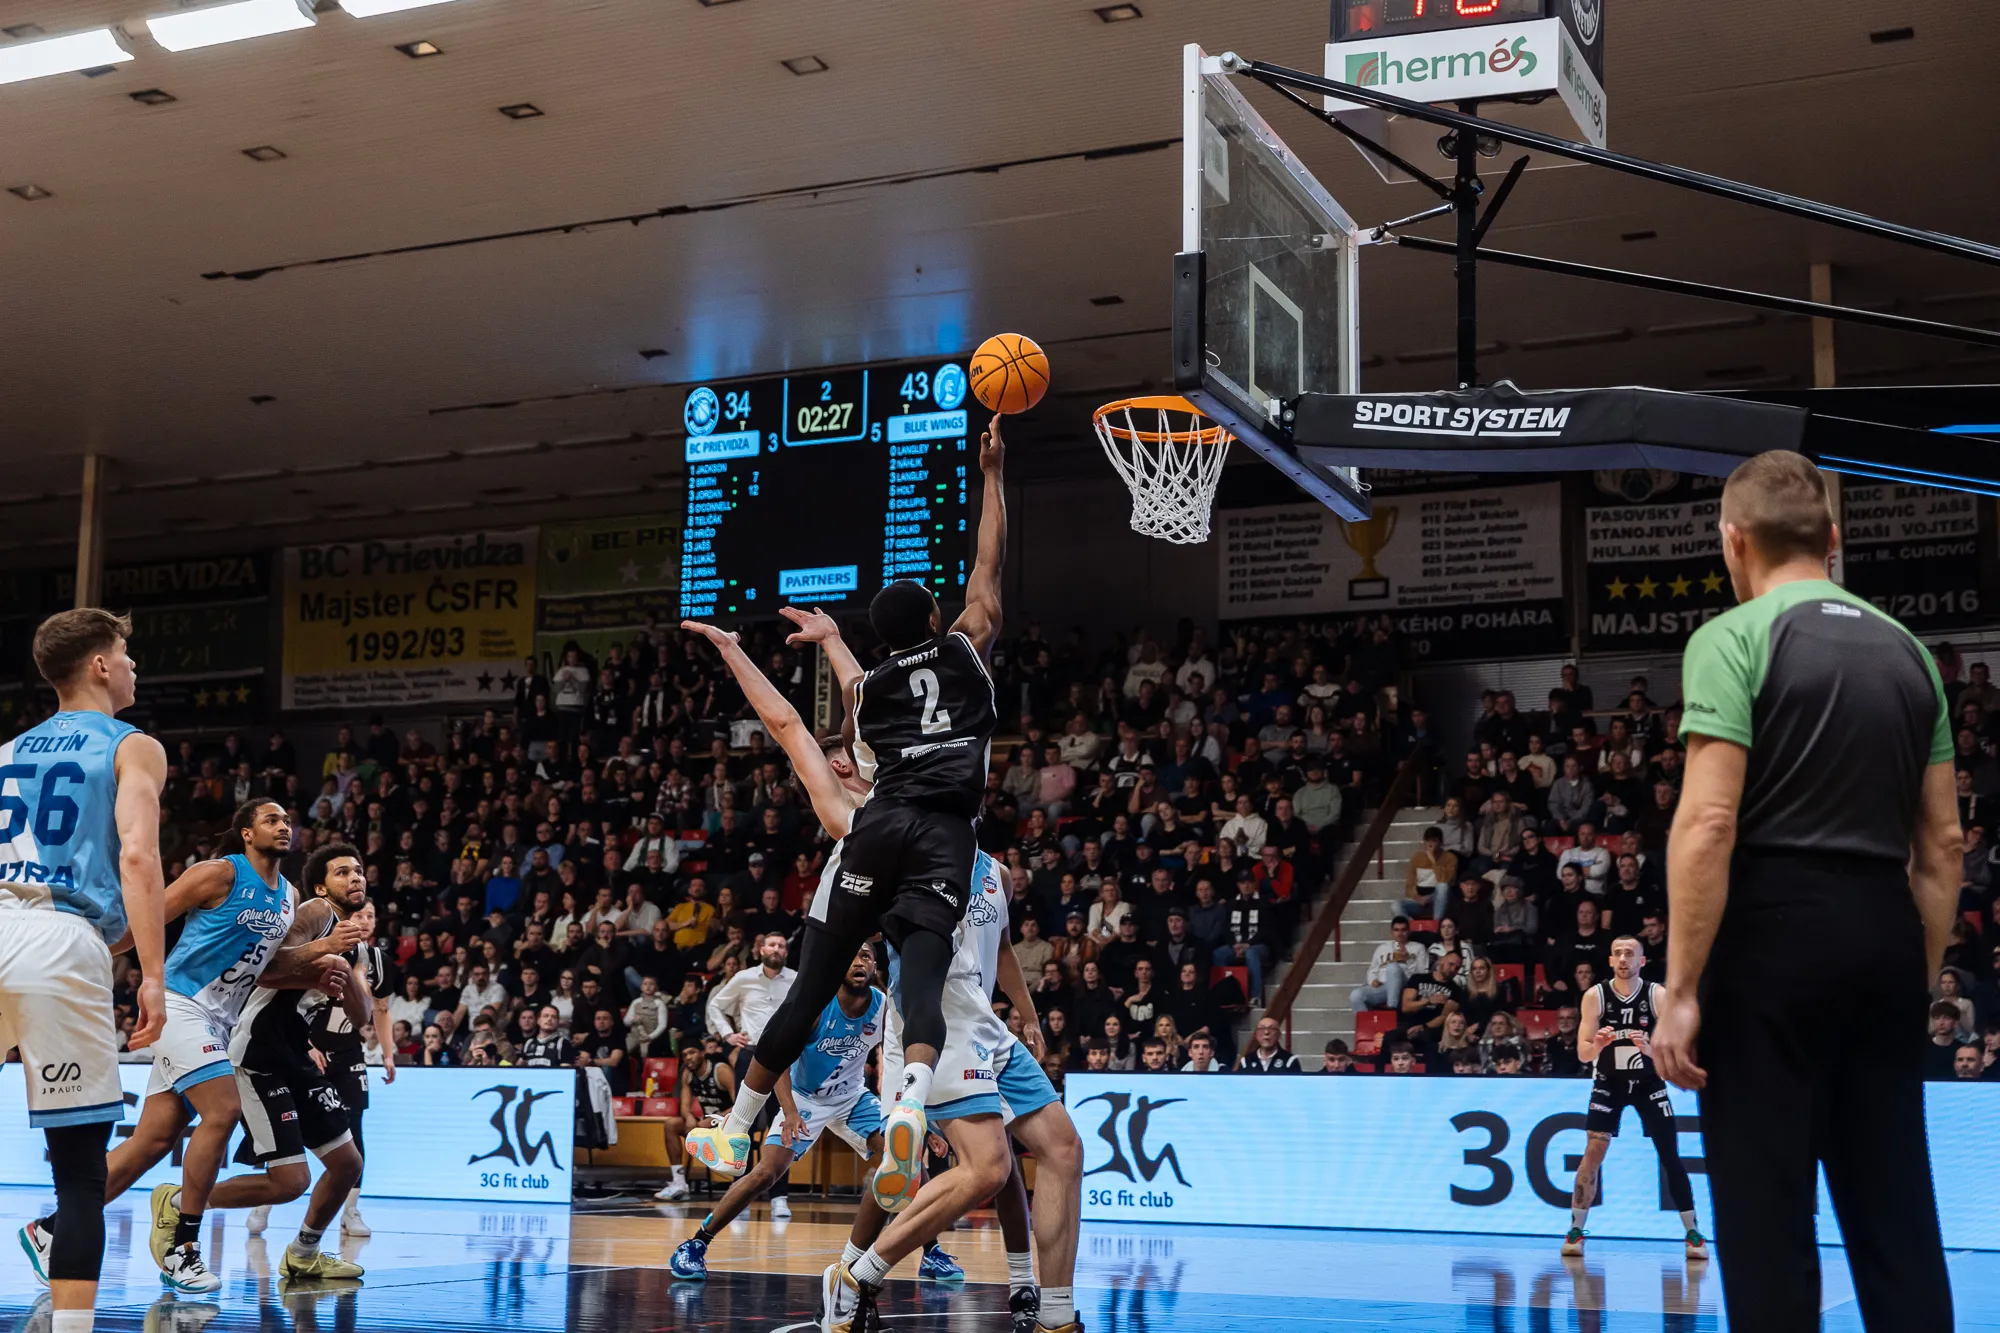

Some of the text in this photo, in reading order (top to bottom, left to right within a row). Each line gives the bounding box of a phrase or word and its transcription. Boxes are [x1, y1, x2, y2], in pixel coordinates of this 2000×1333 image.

[1381, 35, 1537, 85] hermés
[821, 380, 832, 401] 2
[900, 371, 928, 401] 43
[724, 390, 751, 420] 34
[797, 402, 854, 434] 02:27
[904, 416, 963, 434] BLUE WINGS
[1355, 401, 1571, 434] SPORT SYSTEM
[871, 422, 881, 442] 5
[689, 438, 750, 454] BC PRIEVIDZA
[767, 432, 778, 453] 3
[956, 438, 966, 451] 11
[690, 464, 695, 476] 1
[889, 458, 896, 470] 2
[688, 477, 695, 489] 2
[752, 471, 760, 483] 7
[889, 472, 896, 483] 3
[956, 465, 966, 478] 11
[959, 479, 966, 491] 4
[688, 490, 695, 501] 3
[885, 512, 895, 523] 11
[958, 519, 966, 531] 2
[884, 538, 895, 550] 17
[1593, 543, 1662, 558] HULJAK
[301, 533, 524, 580] BC Prievidza
[681, 554, 692, 566] 22
[883, 551, 894, 564] 21
[958, 560, 965, 571] 1
[104, 555, 257, 598] PRIEVIDZA
[786, 572, 851, 588] PARTNERS
[300, 590, 416, 627] Majster
[427, 575, 519, 614] ČSFR
[745, 588, 757, 600] 15
[680, 605, 691, 618] 77
[1459, 607, 1553, 630] POHÁRA
[1592, 605, 1733, 635] MAJSTE
[346, 626, 465, 662] 1992/93
[908, 668, 952, 735] 2
[16, 729, 89, 754] FOLTÍN
[0, 761, 86, 846] 56
[236, 908, 264, 925] Blue
[240, 941, 269, 966] 25
[1620, 1008, 1634, 1025] 77
[817, 1036, 842, 1052] Blue
[1449, 1110, 1603, 1209] 3G
[480, 1172, 550, 1189] 3G fit club
[1088, 1190, 1174, 1207] 3G fit club
